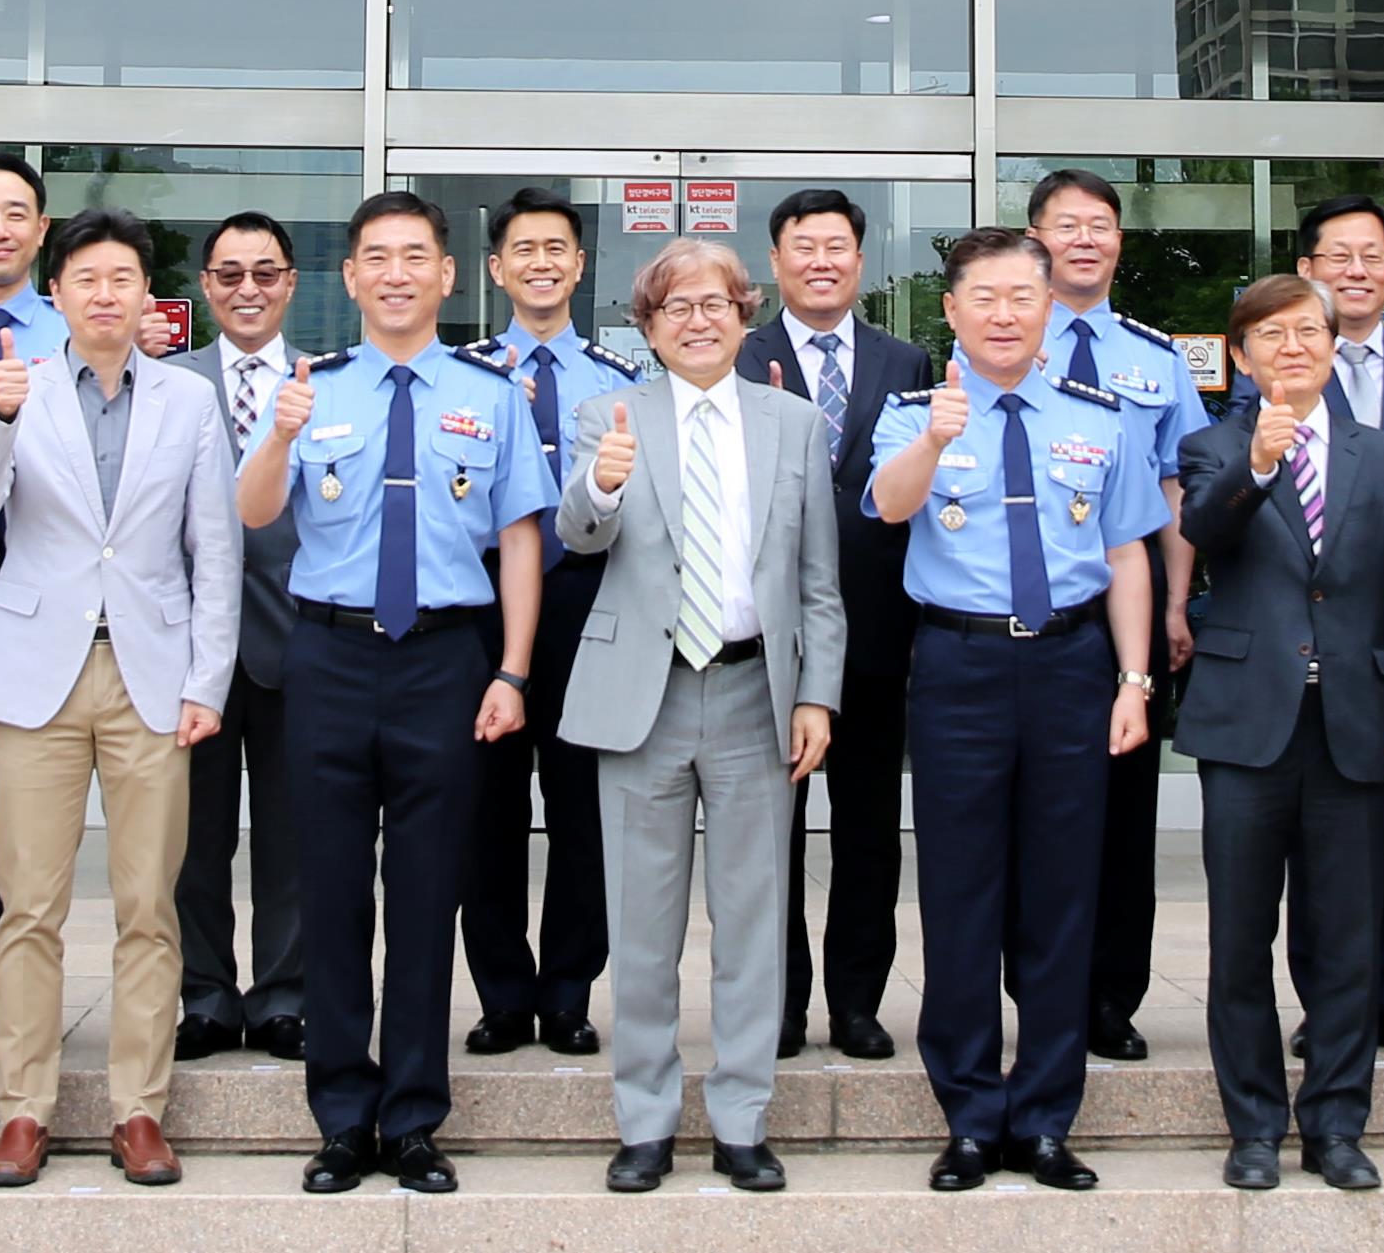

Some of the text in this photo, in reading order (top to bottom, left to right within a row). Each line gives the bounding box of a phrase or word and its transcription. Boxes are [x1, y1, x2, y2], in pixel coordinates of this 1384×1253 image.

[627, 205, 671, 215] kt telecop
[689, 205, 733, 215] kt telecop
